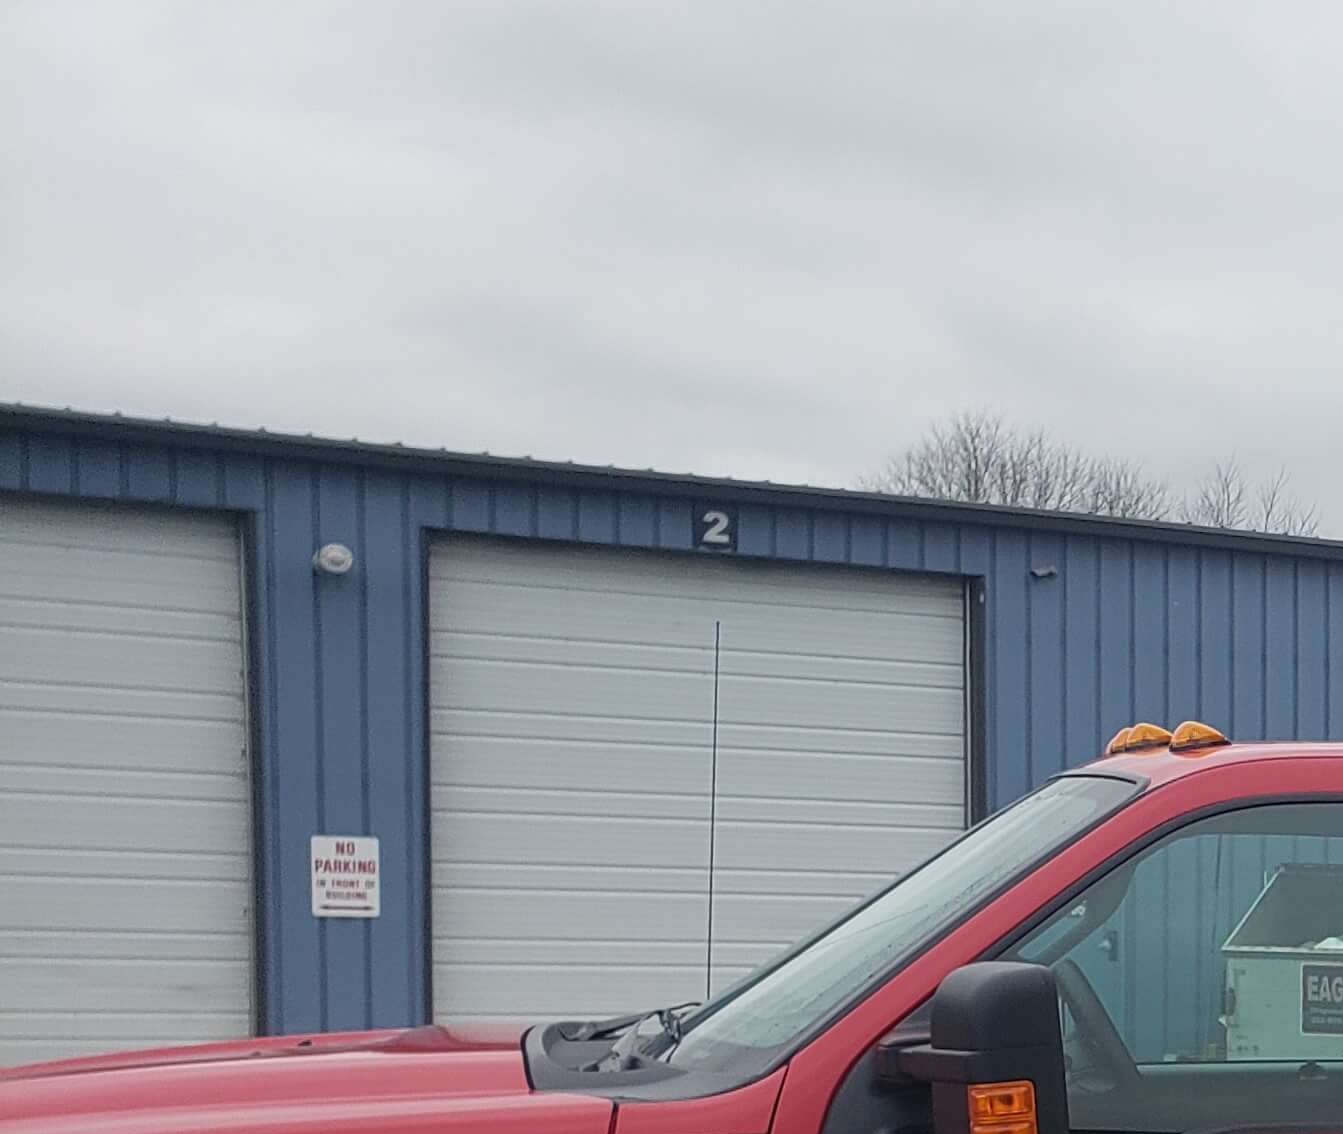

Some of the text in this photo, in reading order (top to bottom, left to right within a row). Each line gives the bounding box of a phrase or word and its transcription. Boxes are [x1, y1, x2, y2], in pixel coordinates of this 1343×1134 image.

[703, 511, 730, 544] 2
[336, 842, 355, 856] NO
[315, 859, 376, 873] PARKING
